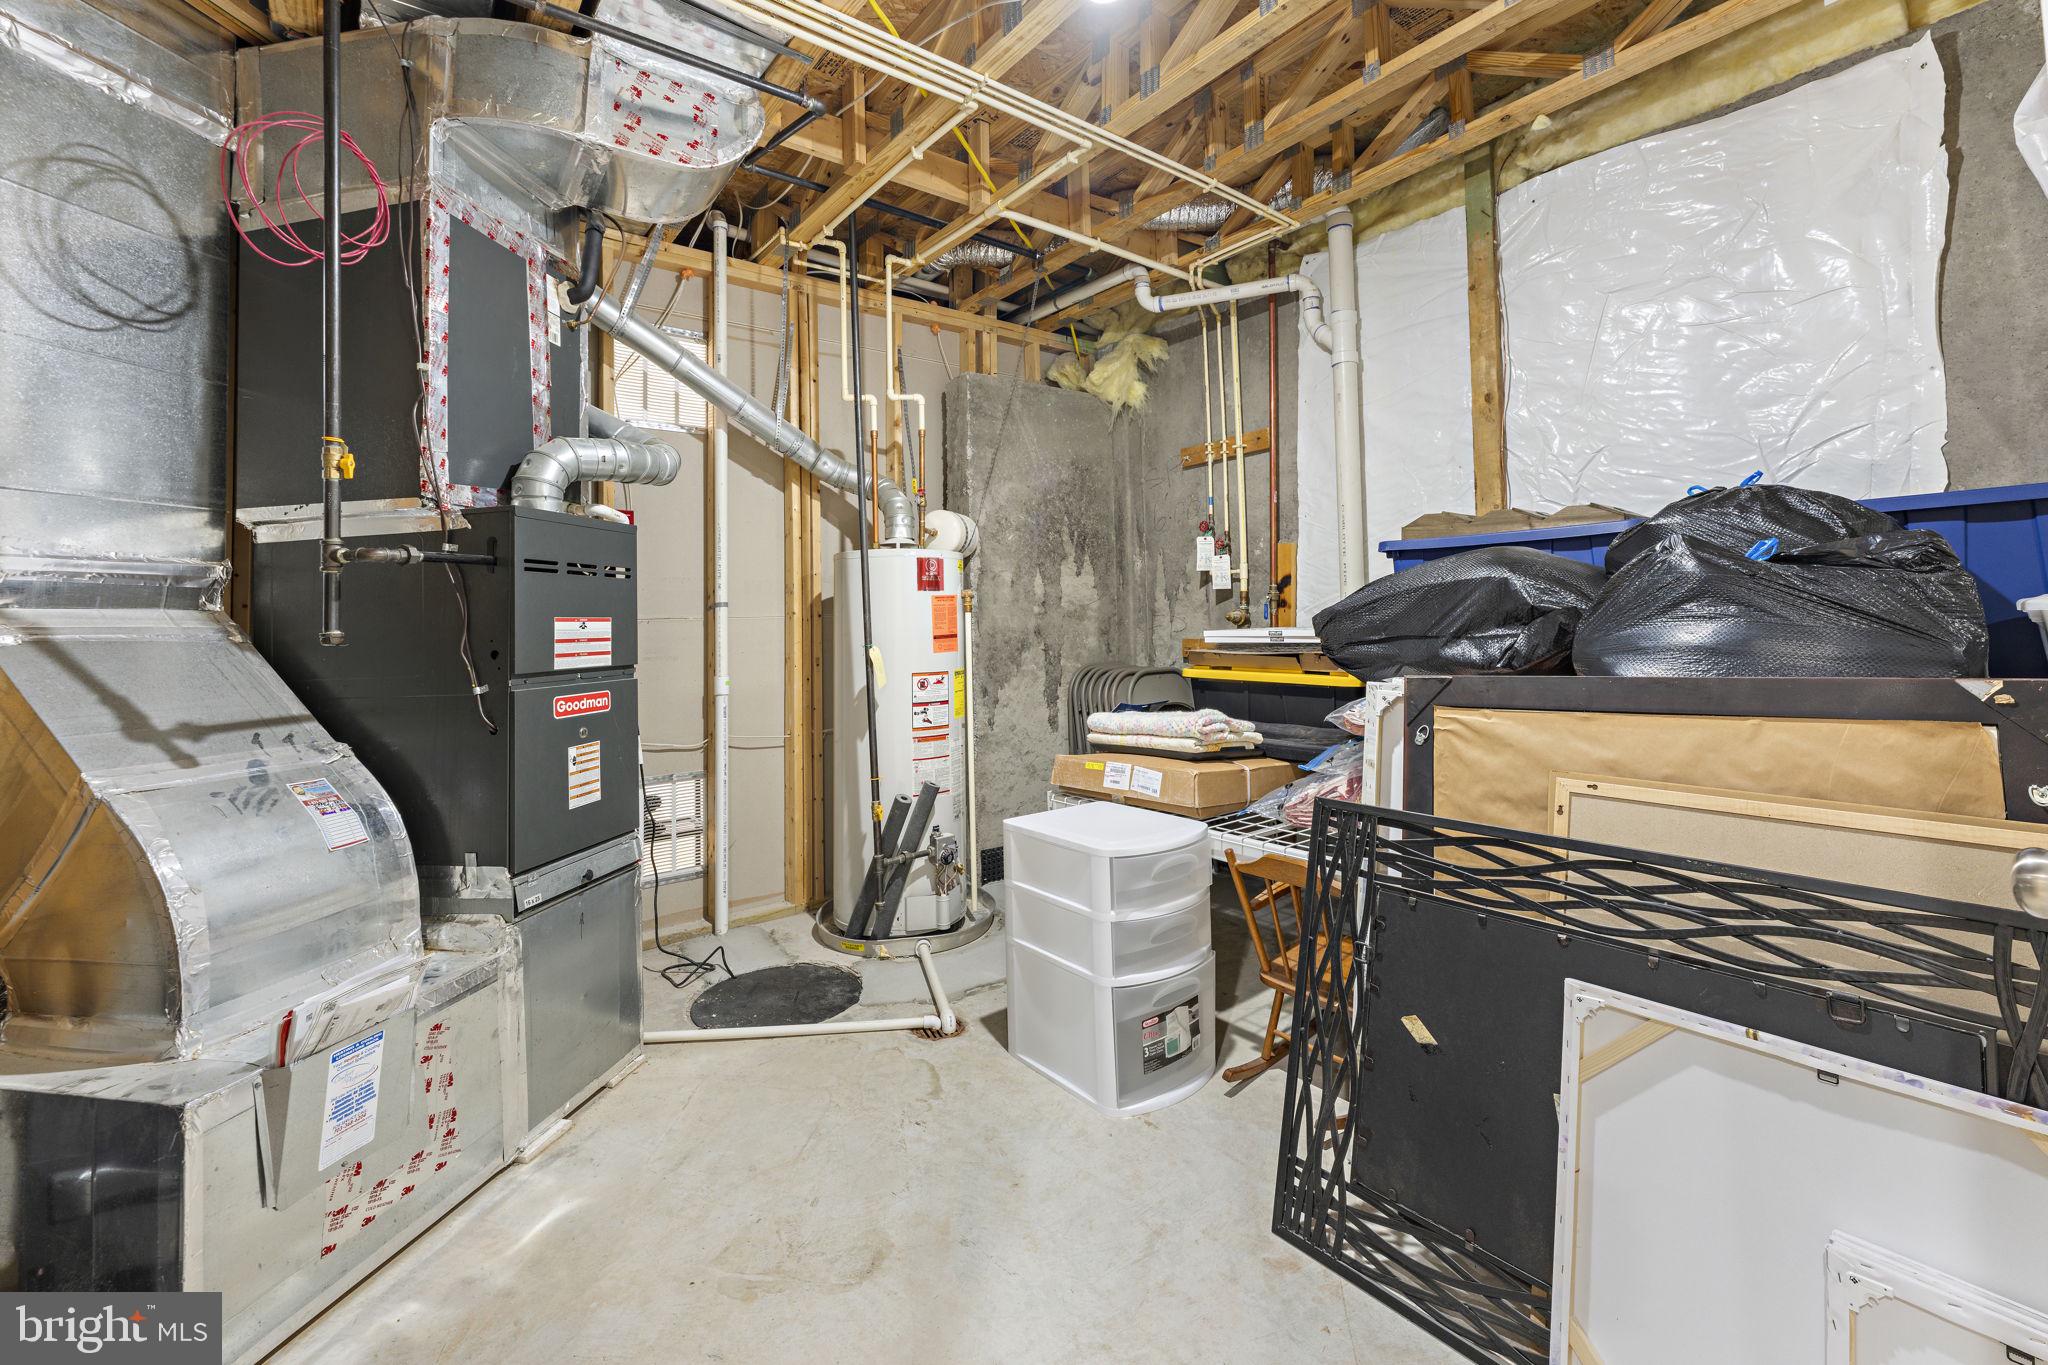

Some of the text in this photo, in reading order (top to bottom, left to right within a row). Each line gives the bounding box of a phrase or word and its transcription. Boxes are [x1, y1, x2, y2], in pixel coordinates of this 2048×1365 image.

[557, 696, 609, 713] Goodman
[430, 1023, 443, 1031] 3M
[1144, 1047, 1149, 1058] 3
[420, 1055, 433, 1064] 3M
[443, 1128, 455, 1138] 3M
[411, 1149, 424, 1161] 3M
[435, 1161, 447, 1171] 3M
[372, 1179, 388, 1190] 3M
[401, 1184, 415, 1197] 3M
[332, 1204, 348, 1217] 3M
[361, 1214, 376, 1227] 3M
[321, 1243, 337, 1258] 3M
